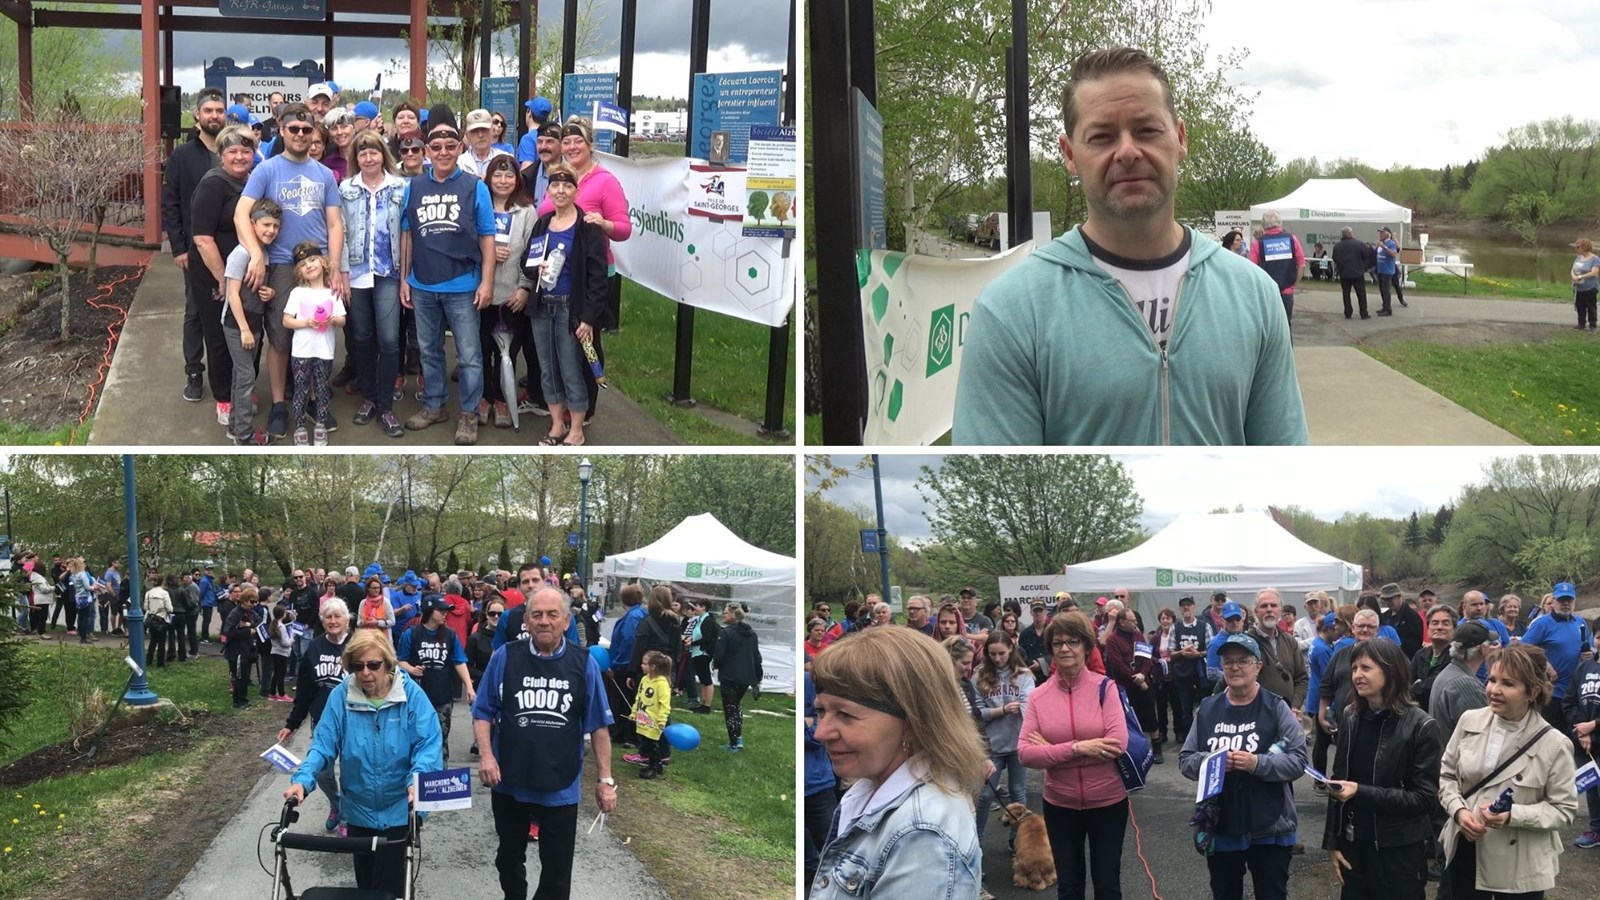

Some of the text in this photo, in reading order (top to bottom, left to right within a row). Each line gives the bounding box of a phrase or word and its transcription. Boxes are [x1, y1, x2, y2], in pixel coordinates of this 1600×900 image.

[718, 76, 777, 86] Édouard Lacroix,
[730, 87, 778, 97] entrepreneur
[717, 98, 777, 109] forestier influent
[421, 193, 458, 205] Club des
[416, 203, 461, 223] 500 $
[694, 200, 740, 213] SAINT-GEORGES
[1311, 209, 1346, 218] Desjardins
[629, 205, 685, 243] esjardins
[705, 566, 764, 579] Desjardins
[1176, 571, 1239, 585] Desjardins
[1020, 584, 1050, 592] ACCUEIL
[417, 648, 448, 661] 500 $
[314, 661, 342, 677] 1000
[522, 676, 570, 690] Club des
[514, 688, 574, 714] 1000 $
[1214, 721, 1257, 734] Club des
[1245, 732, 1260, 753] $
[424, 778, 451, 787] MARCHONS
